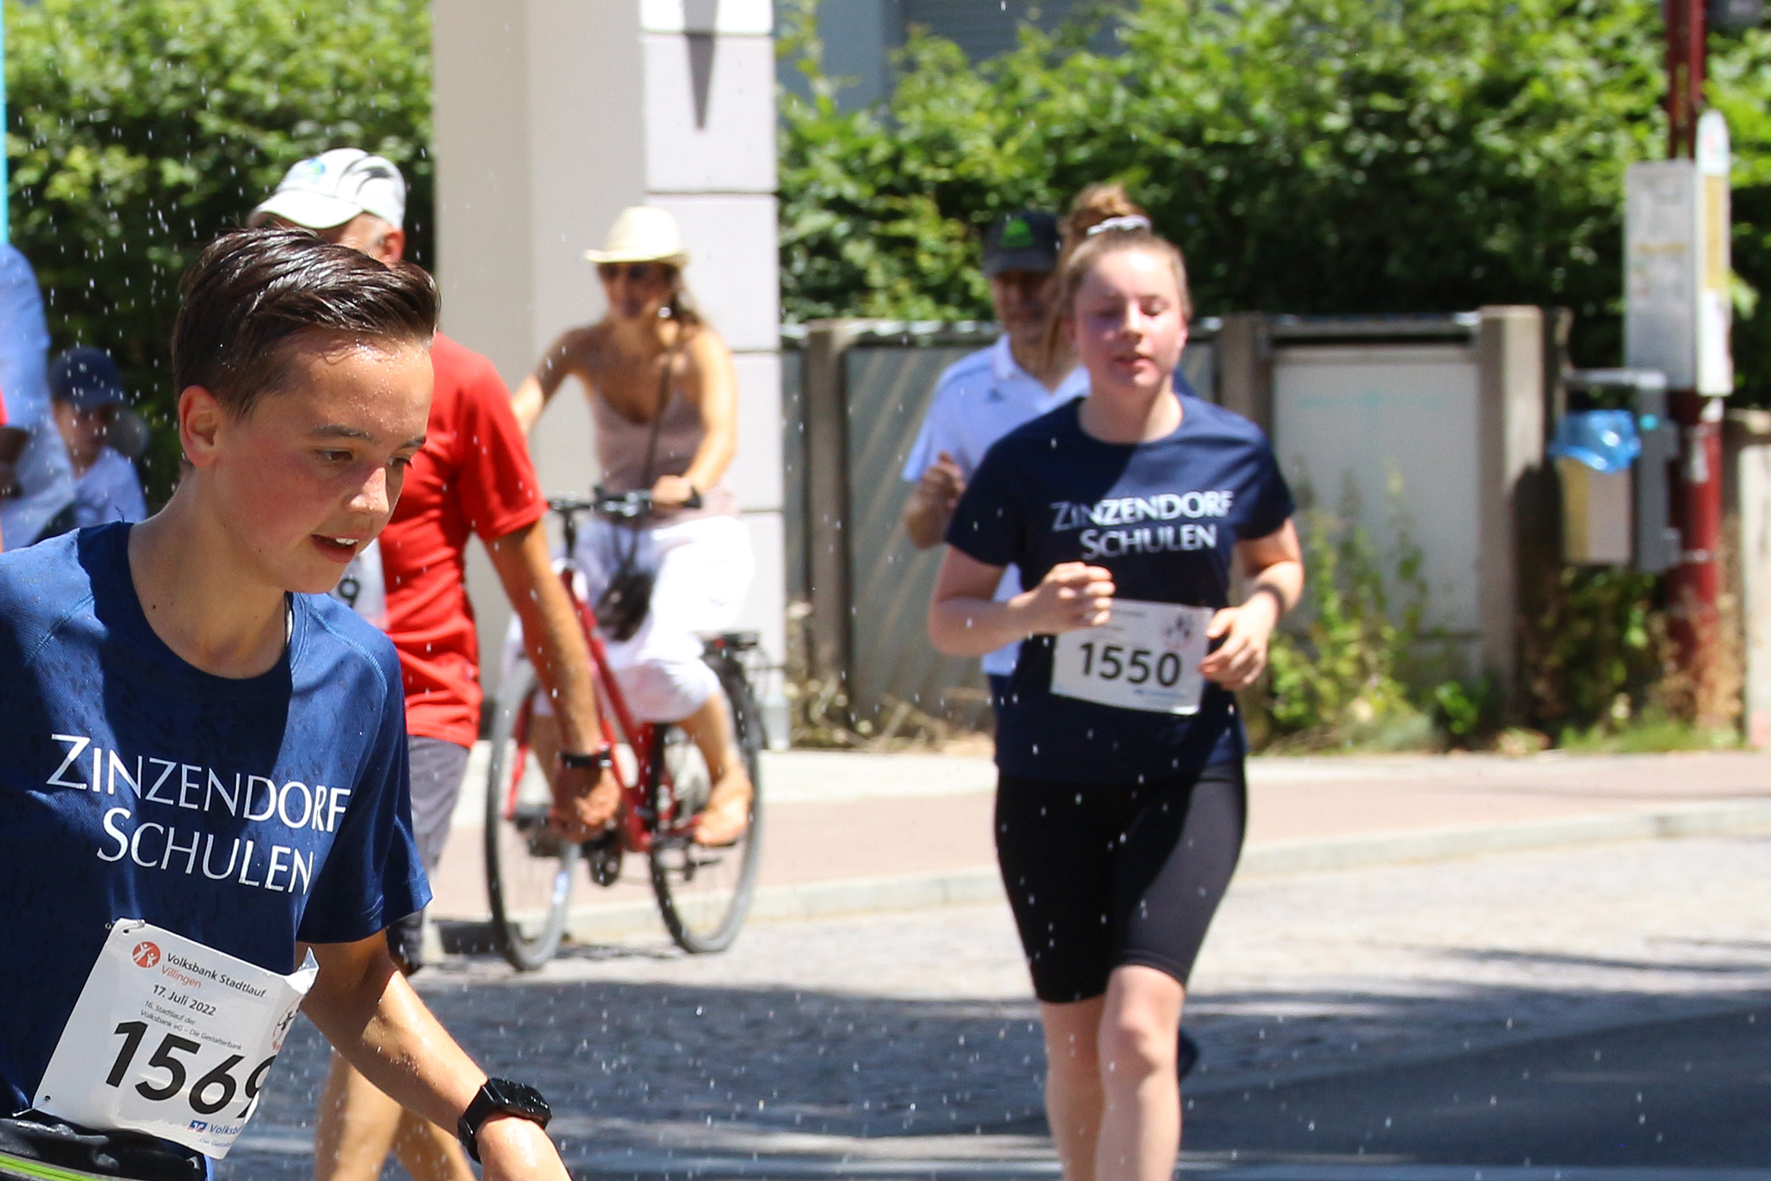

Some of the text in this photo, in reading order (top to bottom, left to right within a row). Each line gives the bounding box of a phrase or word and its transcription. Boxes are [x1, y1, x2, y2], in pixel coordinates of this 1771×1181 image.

[1050, 490, 1234, 532] ZINZENDORF
[1079, 523, 1218, 561] SCHULEN
[1080, 642, 1182, 688] 1550
[46, 733, 352, 833] ZINZENDORF
[96, 806, 315, 895] SCHULEN
[160, 965, 202, 990] Villingen
[167, 952, 267, 999] Volksbank Stadtlauf
[140, 1009, 172, 1028] Volksbank
[153, 984, 217, 1017] 17. Juli 2022
[155, 1005, 185, 1020] Stadtlauf
[184, 1016, 196, 1026] der
